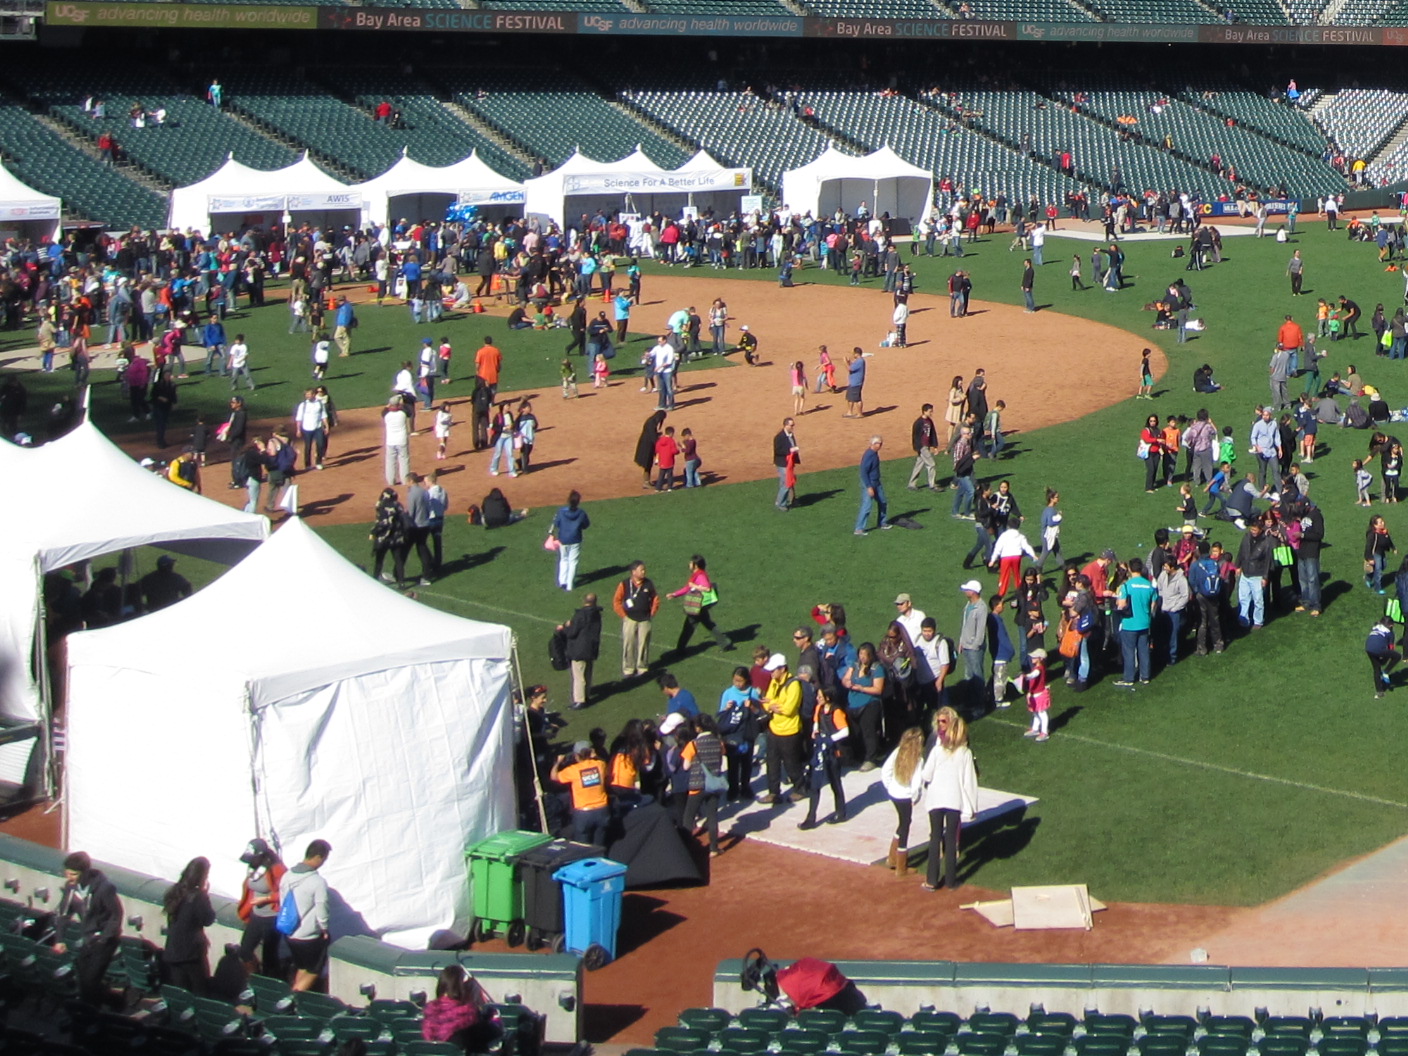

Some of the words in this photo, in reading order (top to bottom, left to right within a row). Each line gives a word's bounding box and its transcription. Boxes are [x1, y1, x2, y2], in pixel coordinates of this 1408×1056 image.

[55, 4, 89, 23] UCSF
[96, 7, 178, 24] advancing
[183, 7, 230, 22] health
[235, 8, 312, 24] worldwide
[356, 12, 383, 29] Bay
[387, 13, 420, 27] Area
[425, 13, 492, 29] SCIENCE
[496, 15, 565, 30] FESTIVAL
[583, 15, 613, 32] UCSF
[618, 17, 686, 33] advancing
[690, 17, 729, 31] health
[733, 19, 798, 32] worldwide
[836, 22, 860, 37] Bay
[863, 22, 892, 35] Area
[895, 22, 949, 36] SCIENCE
[951, 23, 1007, 37] FESTIVAL
[1022, 24, 1046, 39] UCSF
[1050, 25, 1104, 40] advancing
[1107, 25, 1139, 38] health
[1142, 26, 1194, 39] worldwide
[1225, 29, 1244, 43] Bay
[1246, 29, 1270, 41] Area
[1272, 29, 1320, 42] SCIENCE
[1322, 30, 1374, 42] FESTIVAL
[604, 178, 640, 187] Science
[642, 178, 657, 187] For
[659, 178, 666, 186] A
[668, 177, 695, 186] Better
[698, 177, 715, 186] Life
[326, 194, 350, 203] AWIS
[489, 191, 525, 201] AMGEN
